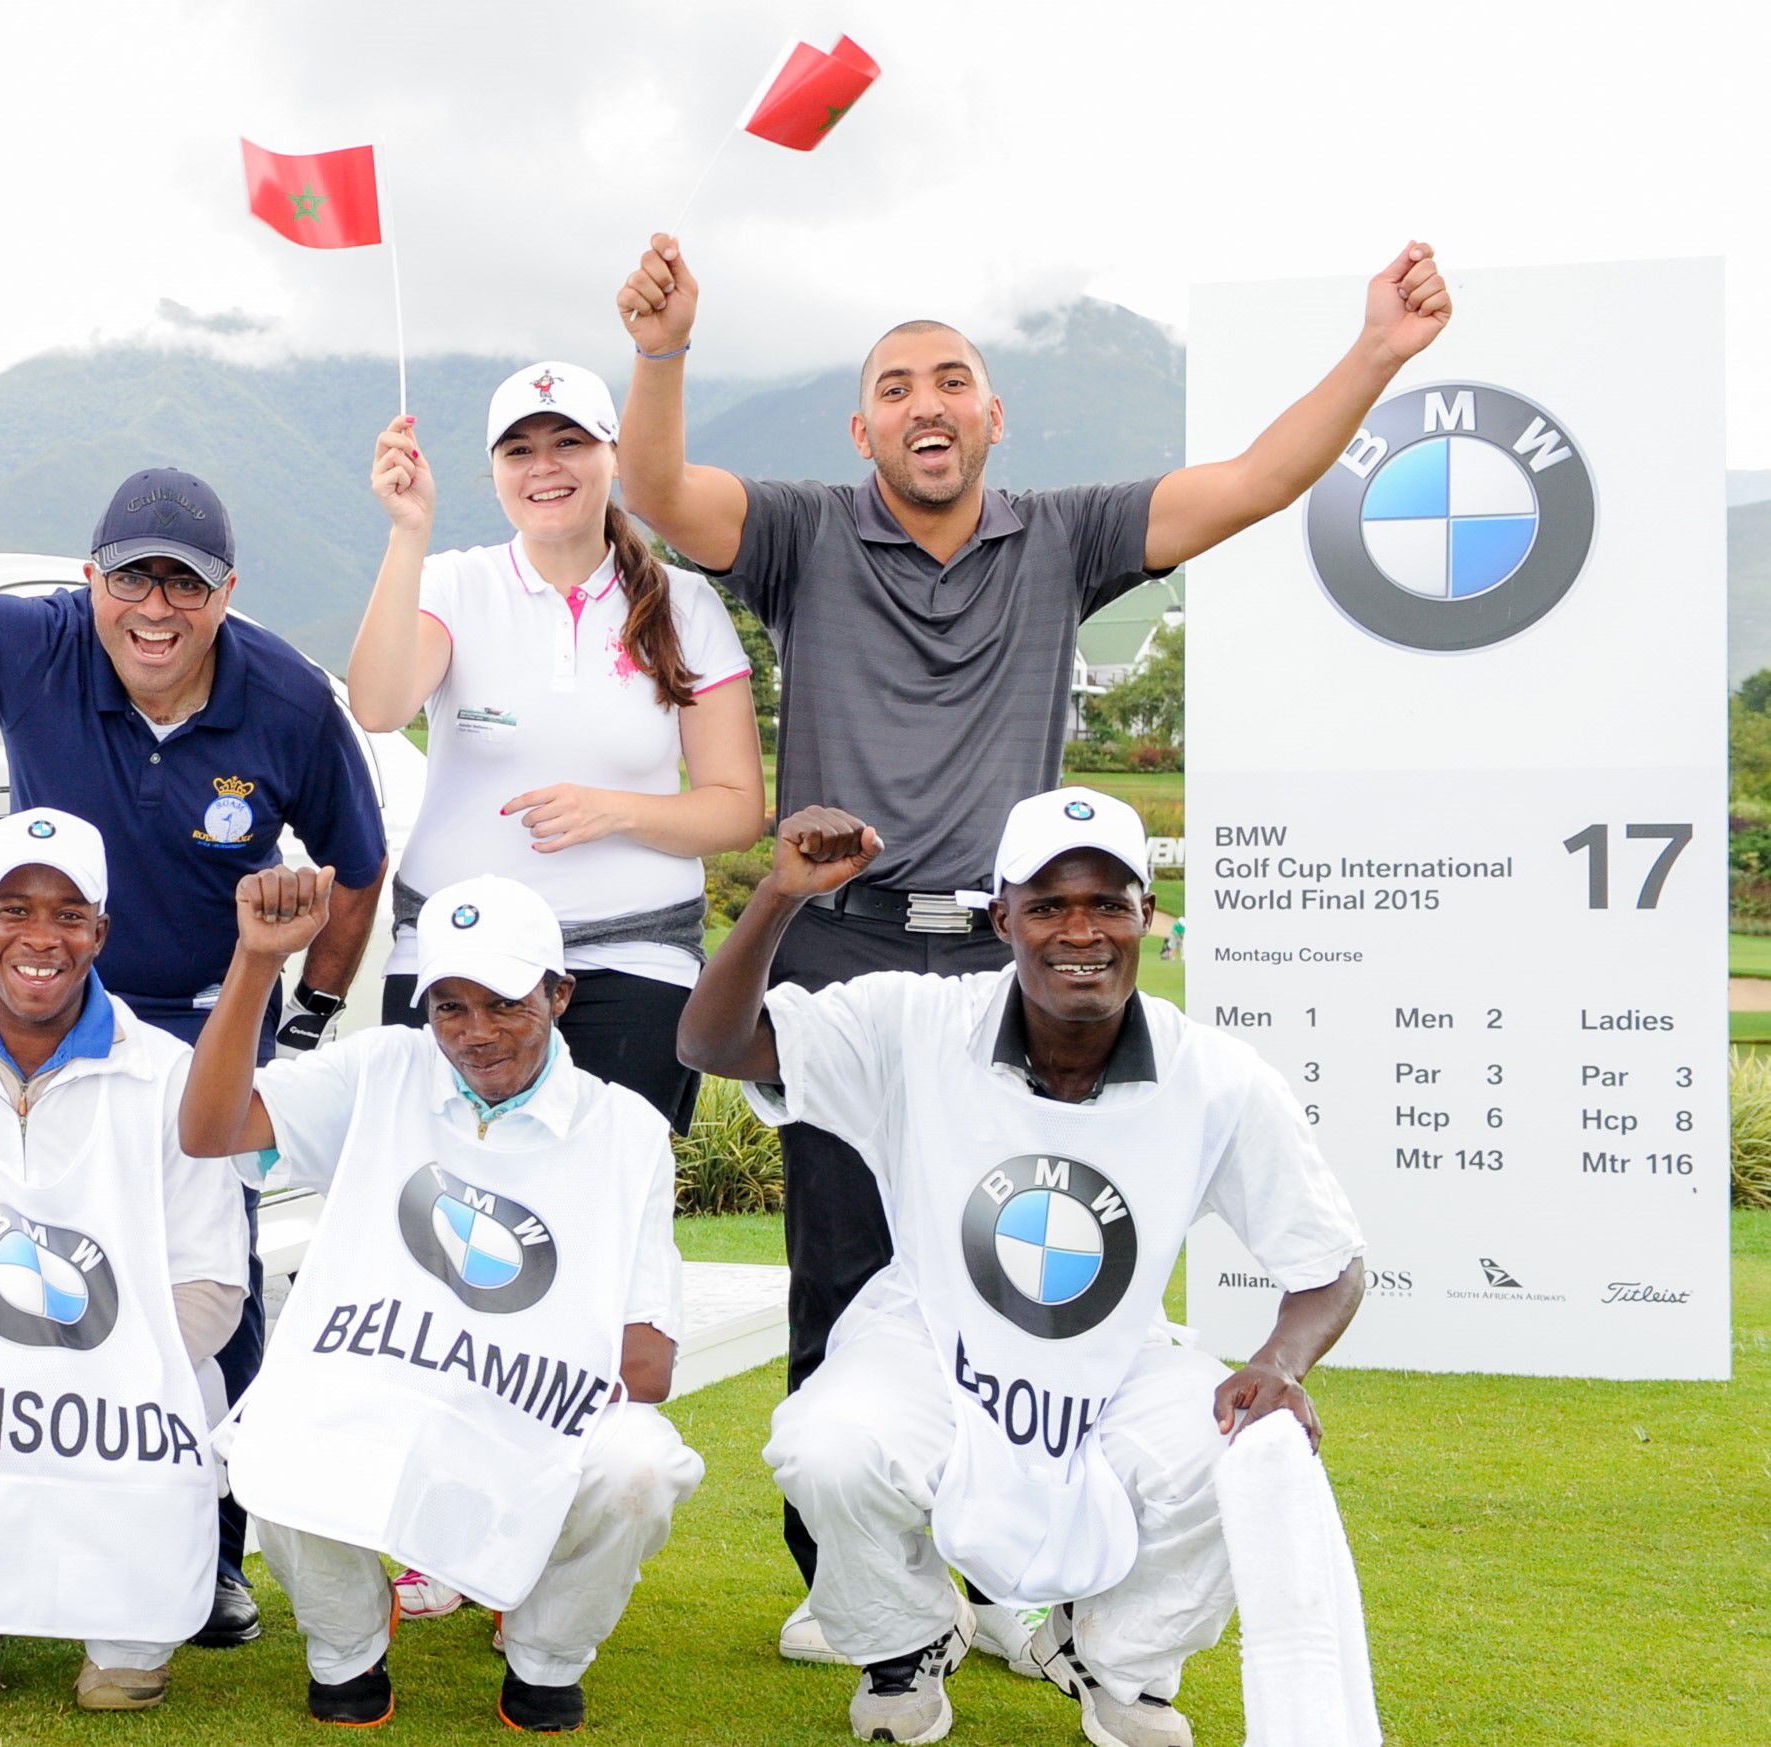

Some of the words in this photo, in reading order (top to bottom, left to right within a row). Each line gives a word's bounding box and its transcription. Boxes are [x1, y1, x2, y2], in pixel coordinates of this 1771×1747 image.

[1337, 390, 1573, 480] BMW
[1215, 825, 1288, 847] BMW
[1214, 857, 1270, 879] Golf
[1277, 857, 1332, 883] Cup
[1341, 856, 1512, 879] International
[1562, 823, 1694, 910] 17
[1214, 889, 1292, 911] World
[1301, 889, 1365, 911] Final
[1374, 889, 1440, 911] 2015
[1214, 947, 1294, 966] Montagu
[1298, 947, 1363, 963] Course
[1215, 1005, 1272, 1027] Men
[1305, 1007, 1317, 1028] 1
[1395, 1007, 1454, 1029] Men
[1486, 1008, 1503, 1030] 2
[1581, 1008, 1675, 1032] Ladies
[1303, 1061, 1320, 1083] 3
[1395, 1062, 1442, 1085] Par
[1486, 1063, 1503, 1086] 3
[1582, 1065, 1629, 1087] Par
[1675, 1066, 1693, 1088] 3
[1305, 1104, 1321, 1126] 6
[1396, 1105, 1450, 1133] Hcp
[1486, 1107, 1503, 1129] 6
[1582, 1108, 1638, 1136] Hcp
[1675, 1110, 1694, 1132] 8
[1396, 1147, 1444, 1170] Mtr
[1455, 1149, 1504, 1172] 143
[1582, 1151, 1631, 1174] Mtr
[1646, 1153, 1694, 1176] 116
[981, 1158, 1128, 1226] BMW
[1364, 1270, 1413, 1290] OSS
[1600, 1282, 1691, 1304] Titleist
[312, 1297, 609, 1437] BELLAMINE
